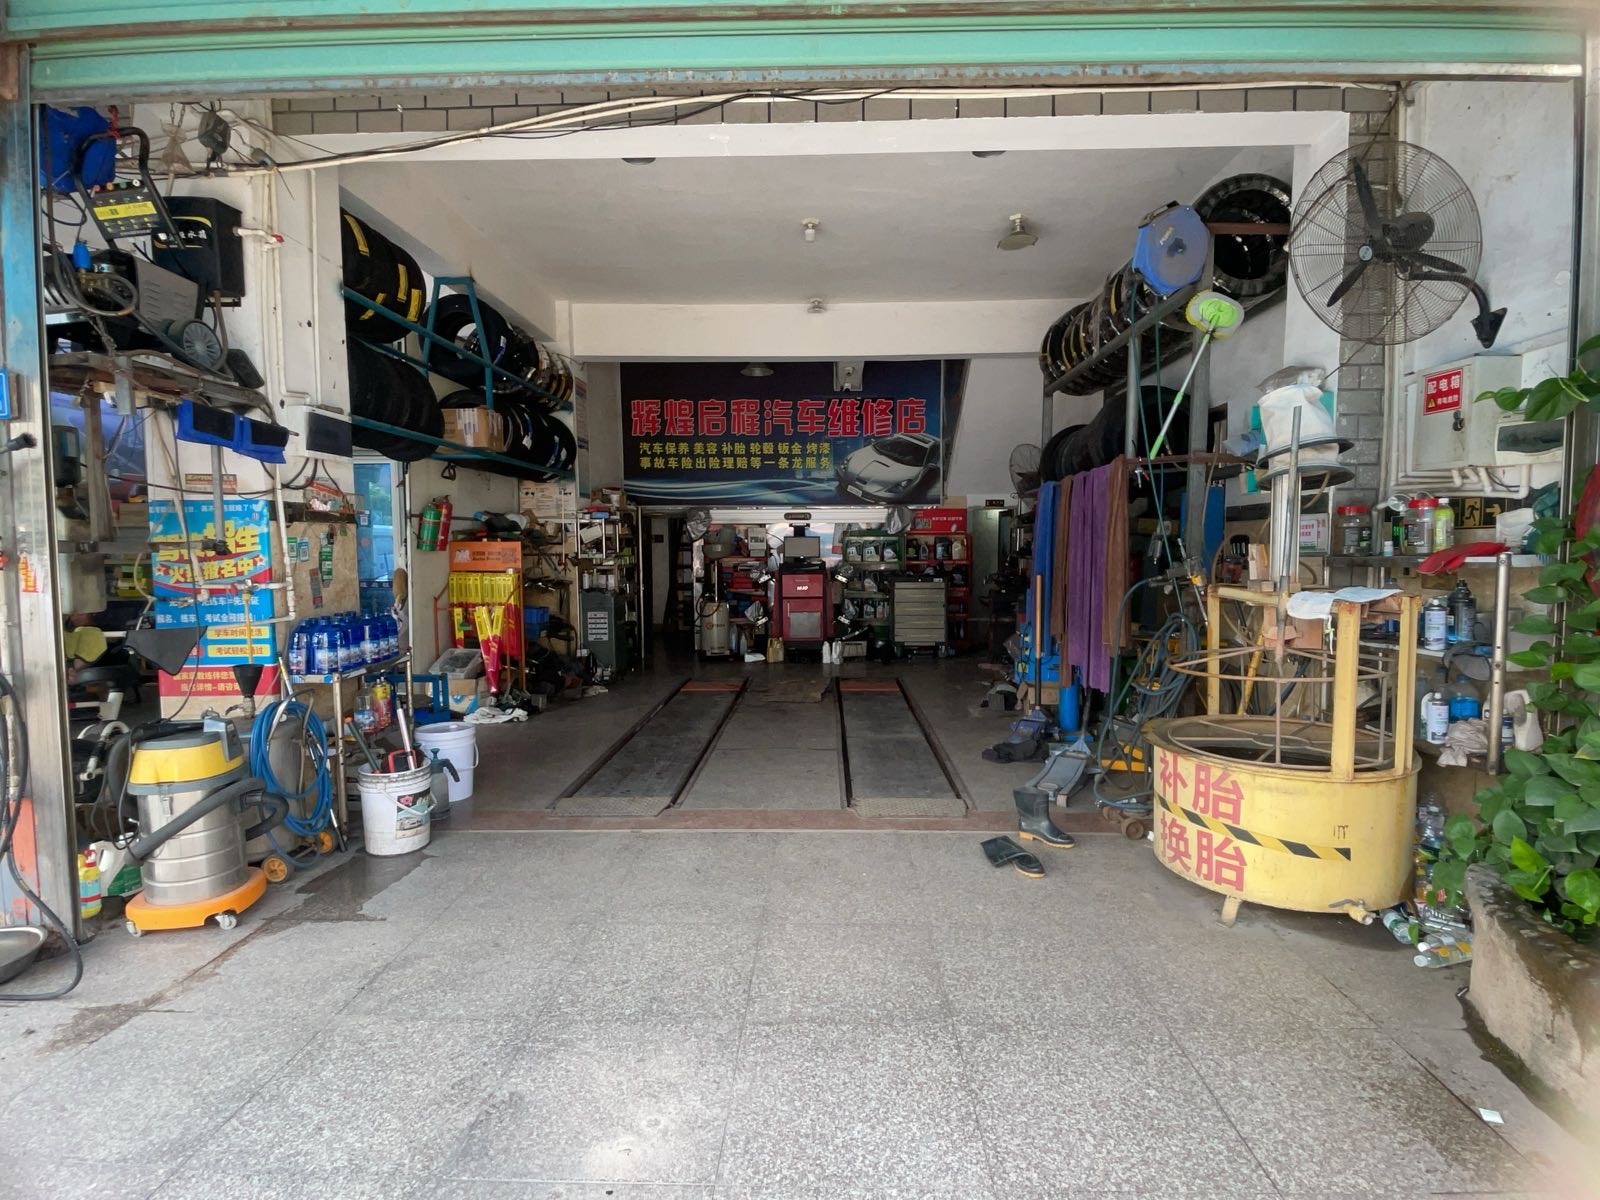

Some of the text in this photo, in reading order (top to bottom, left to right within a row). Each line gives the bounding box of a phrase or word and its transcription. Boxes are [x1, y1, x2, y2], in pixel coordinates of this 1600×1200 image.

[1427, 374, 1461, 395] 配电箱
[631, 398, 926, 437] 辉煌启程汽车维修店
[639, 442, 831, 455] 汽车保养 美容 补胎 轮毂 钣金 烤漆
[639, 456, 832, 470] 事故车险出险理赔等一条龙服务
[1160, 750, 1245, 826] 补胎
[1160, 811, 1248, 892] 换胎
